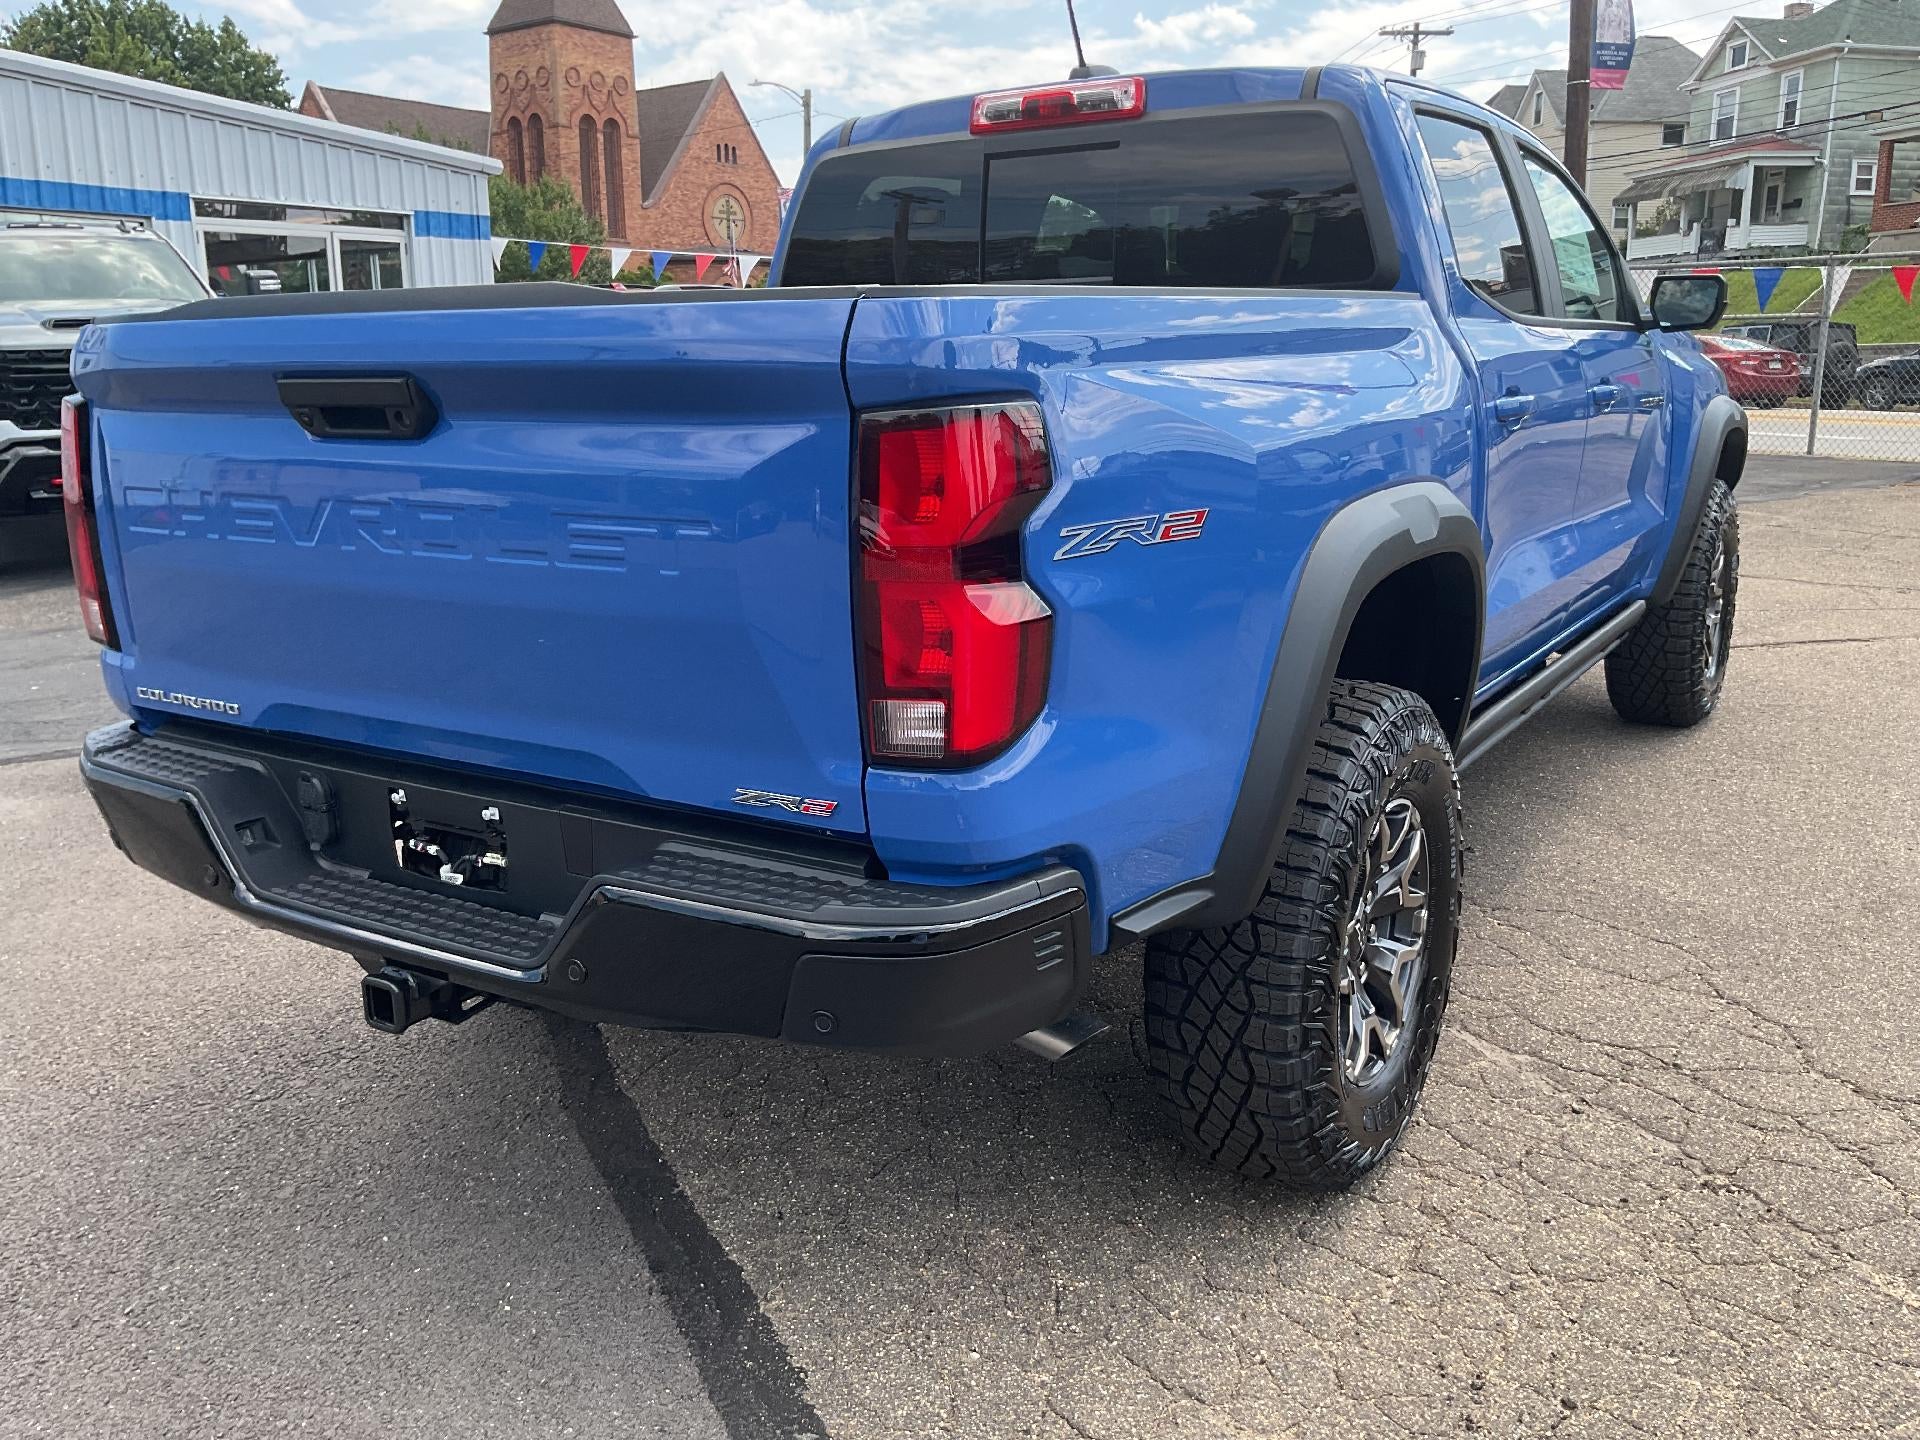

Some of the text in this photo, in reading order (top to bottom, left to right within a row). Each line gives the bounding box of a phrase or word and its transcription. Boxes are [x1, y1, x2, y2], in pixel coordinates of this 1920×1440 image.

[124, 486, 711, 575] CHEVROLET
[1052, 508, 1210, 561] ZR2
[136, 686, 240, 715] COLORADO
[730, 787, 838, 817] ZR2
